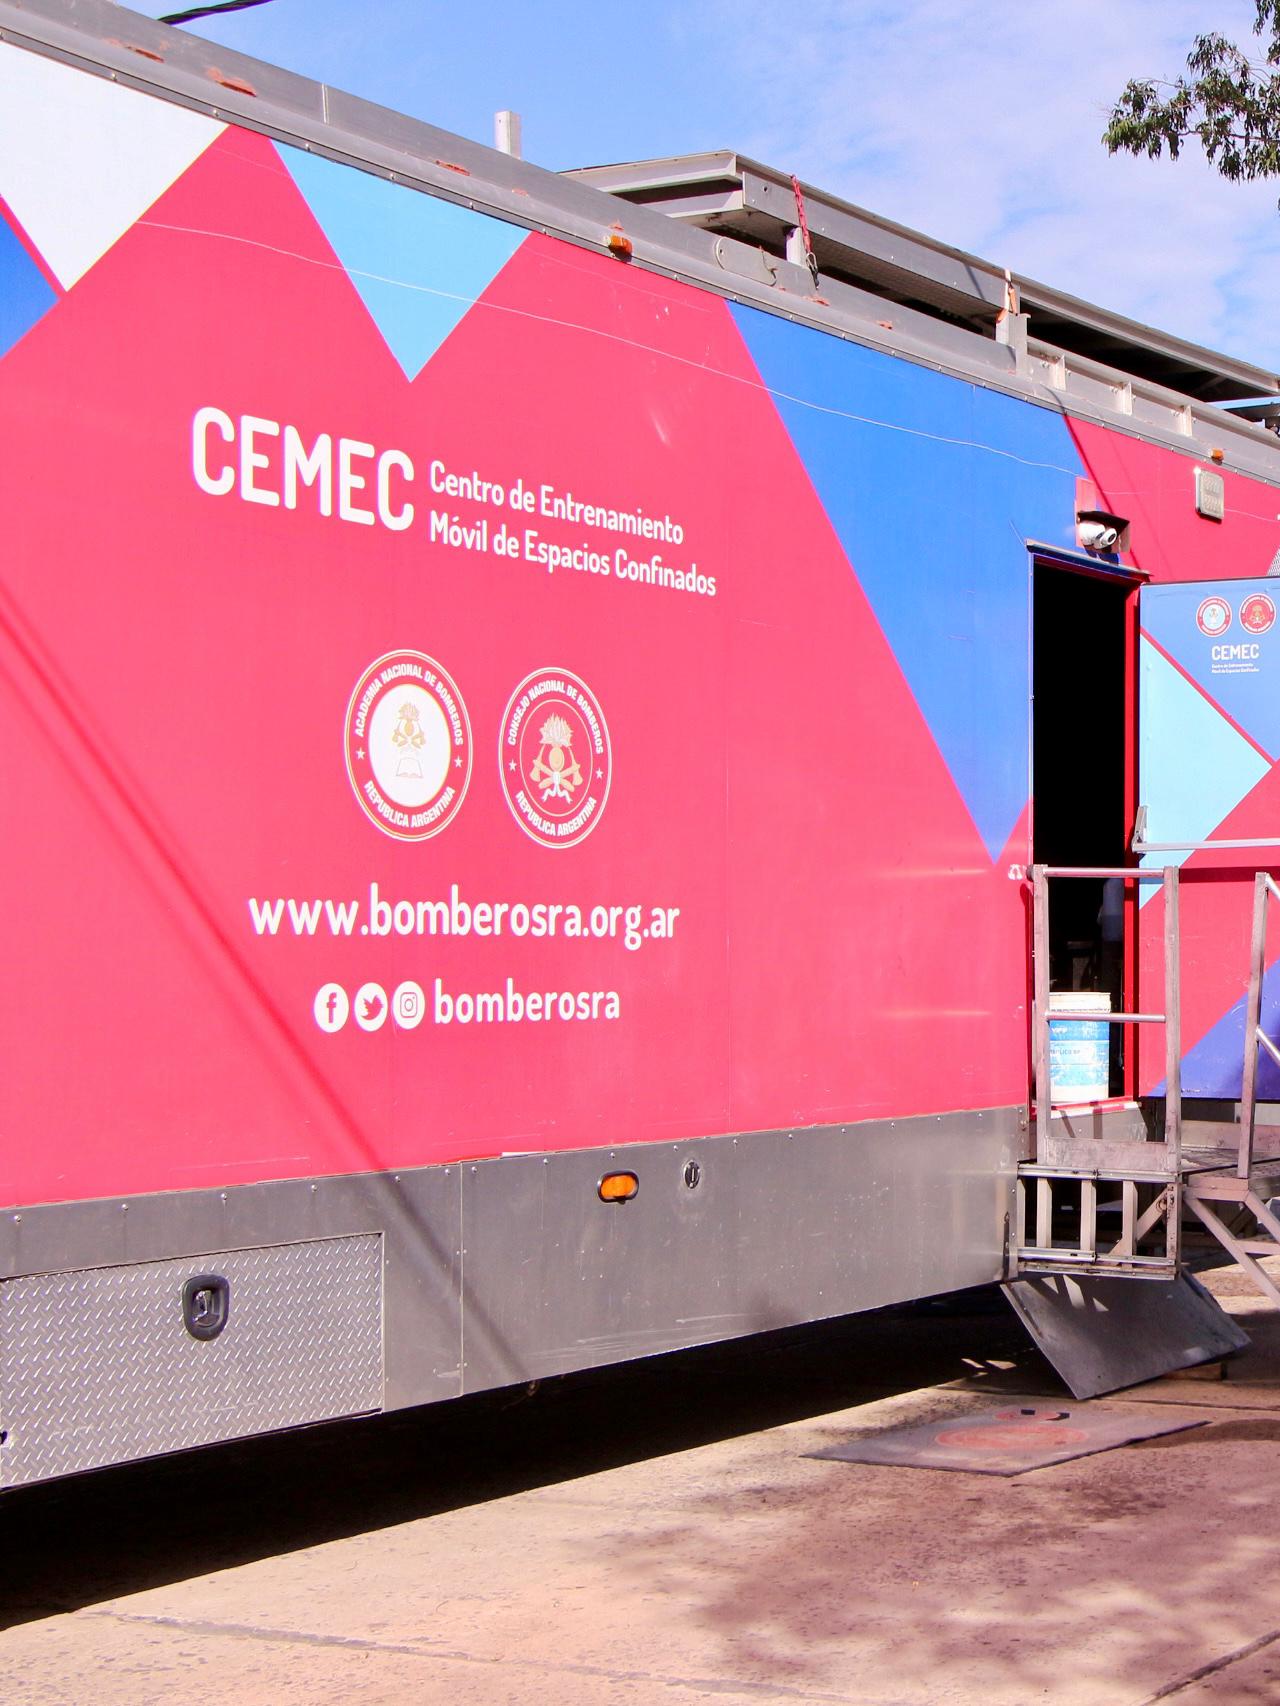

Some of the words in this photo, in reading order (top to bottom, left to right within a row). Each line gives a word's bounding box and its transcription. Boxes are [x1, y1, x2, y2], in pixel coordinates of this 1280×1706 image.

[192, 406, 415, 531] CEMEC
[430, 460, 504, 506] Centro
[509, 479, 535, 514] de
[540, 485, 684, 545] Entrenamiento
[430, 510, 488, 553] Móvil
[493, 525, 519, 558] de
[525, 529, 610, 575] Espacios
[615, 549, 717, 596] Confinados
[1211, 643, 1260, 661] CEMEC
[355, 678, 383, 737] ACADEMIA
[381, 663, 423, 684] NACIONAL
[424, 671, 437, 687] DE
[435, 681, 464, 746] BOMBEROS
[508, 696, 530, 746] CONSEJO
[528, 680, 565, 701] NACIONAL
[566, 684, 578, 700] DE
[577, 694, 604, 754] BOMBEROS
[411, 786, 456, 828] ARGENTINA
[557, 797, 597, 837] ARGENTINA
[248, 882, 681, 951] www.bomberosra.org.ar
[434, 978, 620, 1024] bomberosra
